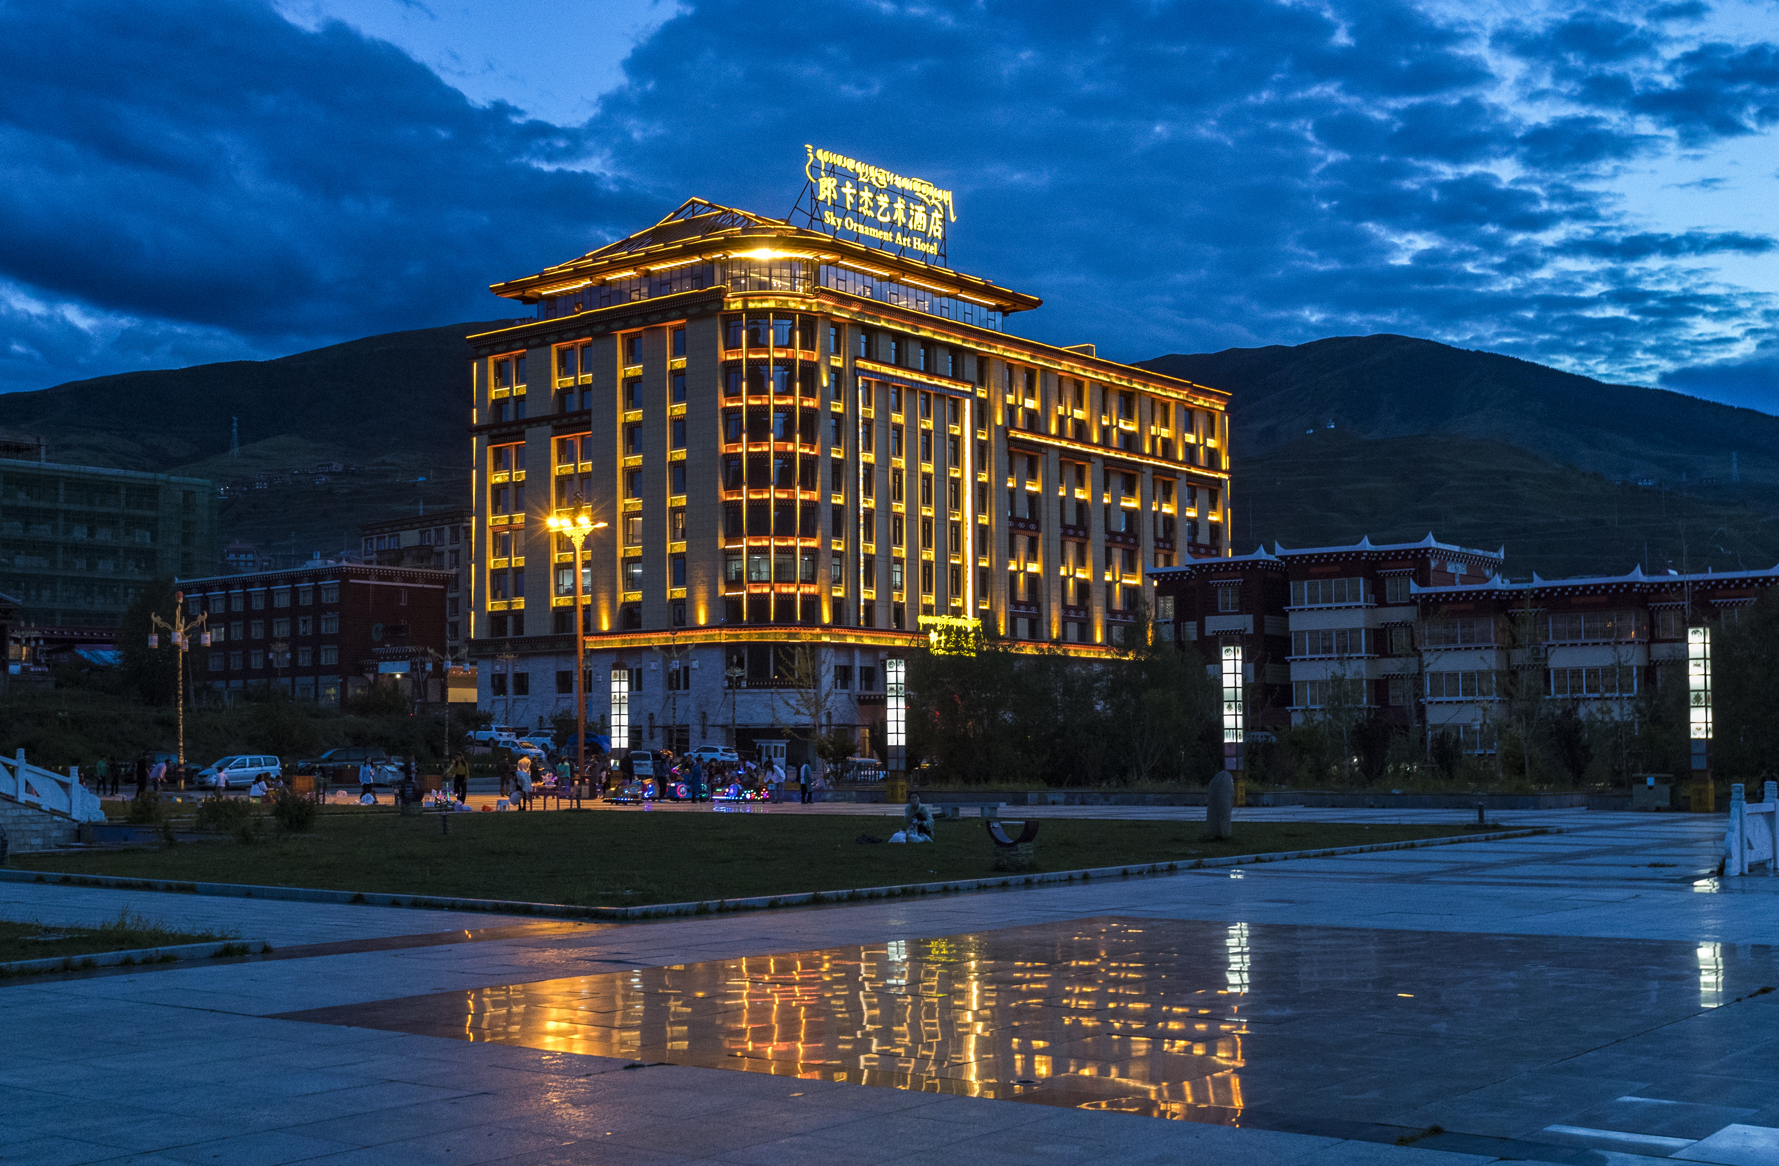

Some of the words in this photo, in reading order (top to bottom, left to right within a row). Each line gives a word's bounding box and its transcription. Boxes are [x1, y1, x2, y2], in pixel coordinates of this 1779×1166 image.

[823, 210, 843, 231] Sky
[844, 216, 894, 243] Ornament
[895, 232, 912, 248] Art
[912, 236, 938, 256] Hotel
